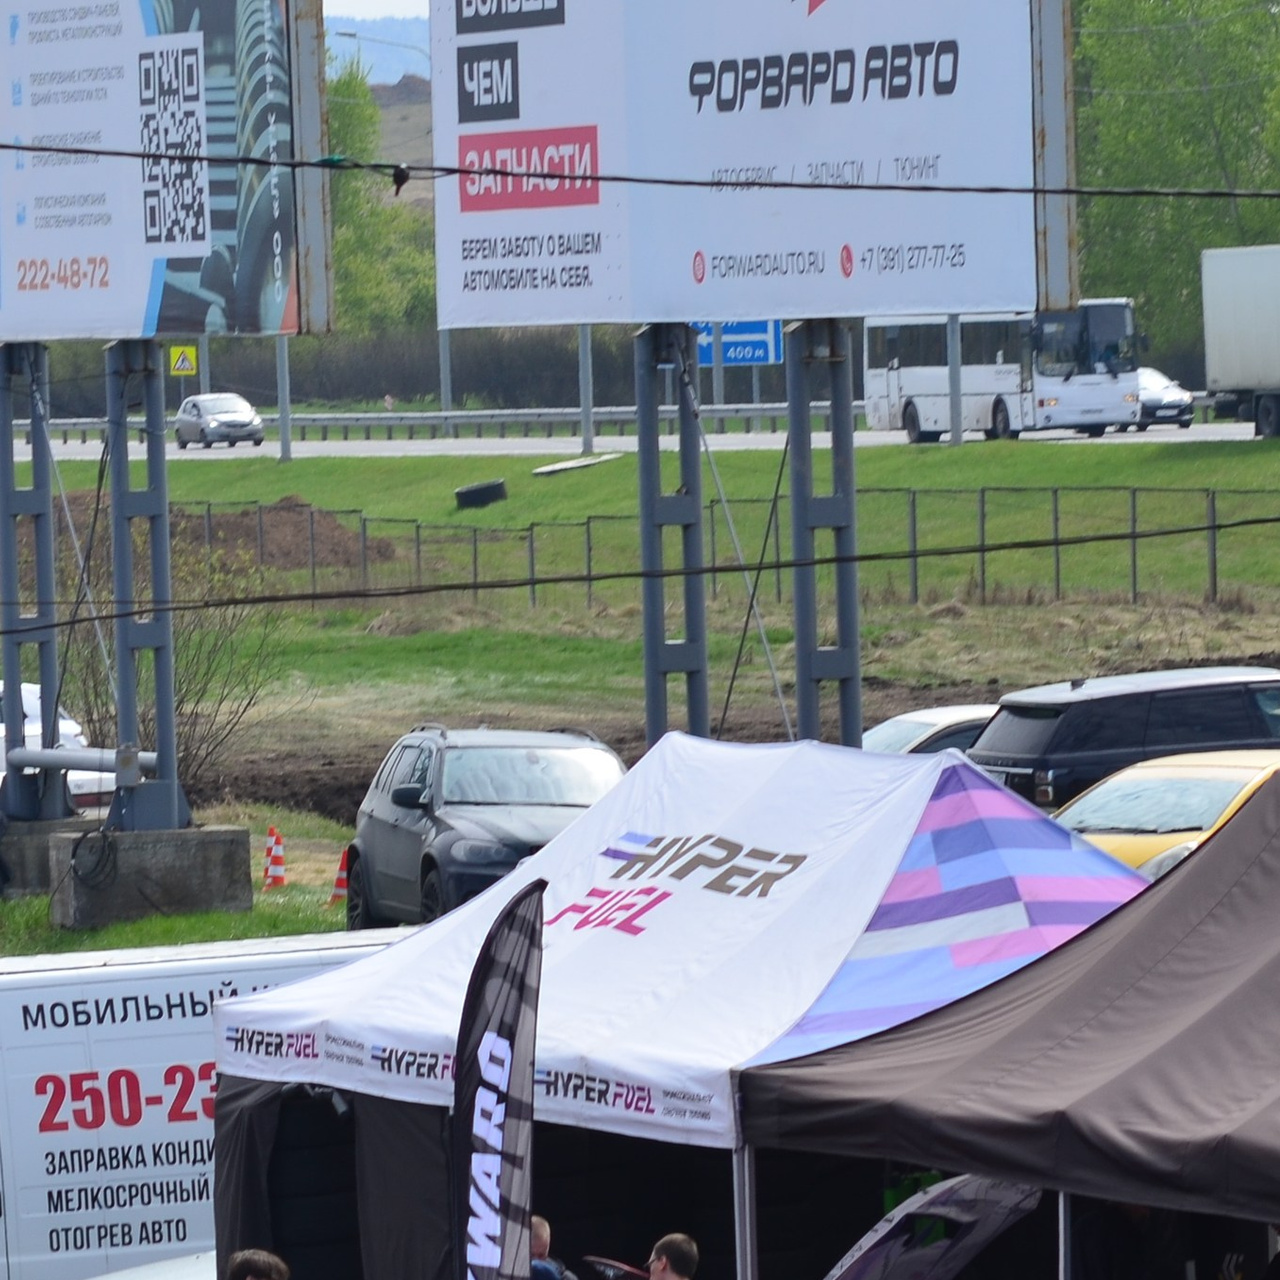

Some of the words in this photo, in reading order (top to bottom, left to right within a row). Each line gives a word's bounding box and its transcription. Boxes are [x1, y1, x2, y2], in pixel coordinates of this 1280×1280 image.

[463, 58, 513, 106] ЧЕМ
[863, 40, 959, 101] АВТО
[465, 142, 593, 196] ЗАПЧАСТИ
[807, 160, 864, 186] ЗАПЧАСТИ
[894, 155, 941, 184] ТЮНИНГ
[462, 237, 498, 261] БЕРЕМ
[500, 235, 545, 258] ЗАБОТУ
[547, 234, 556, 257] О
[558, 232, 601, 256] ВАШЕМ
[860, 249, 873, 269] +7
[877, 245, 905, 275] (391)
[907, 244, 966, 270] 277-77-25
[17, 256, 109, 291] 222-48-72
[462, 268, 538, 292] АВТОМОБИЛЕ
[541, 267, 557, 290] НА
[560, 266, 593, 288] СЕБЯ.
[712, 251, 825, 279] FORWARDAUTO.RU
[727, 346, 753, 359] 400
[600, 832, 808, 899] HYPER
[544, 886, 674, 936] FUEL
[226, 1026, 284, 1058] HYPER
[285, 1032, 320, 1060] FUEL
[371, 1045, 438, 1080] HYPER
[534, 1069, 611, 1107] HYPER
[612, 1081, 657, 1115] FUEL
[45, 1144, 147, 1175] ЗАПРАВКА
[47, 1173, 211, 1214] МЕЛКОСРОЧНЫЙ
[49, 1222, 133, 1252] ОТОГРЕВ
[138, 1218, 188, 1245] АВТО
